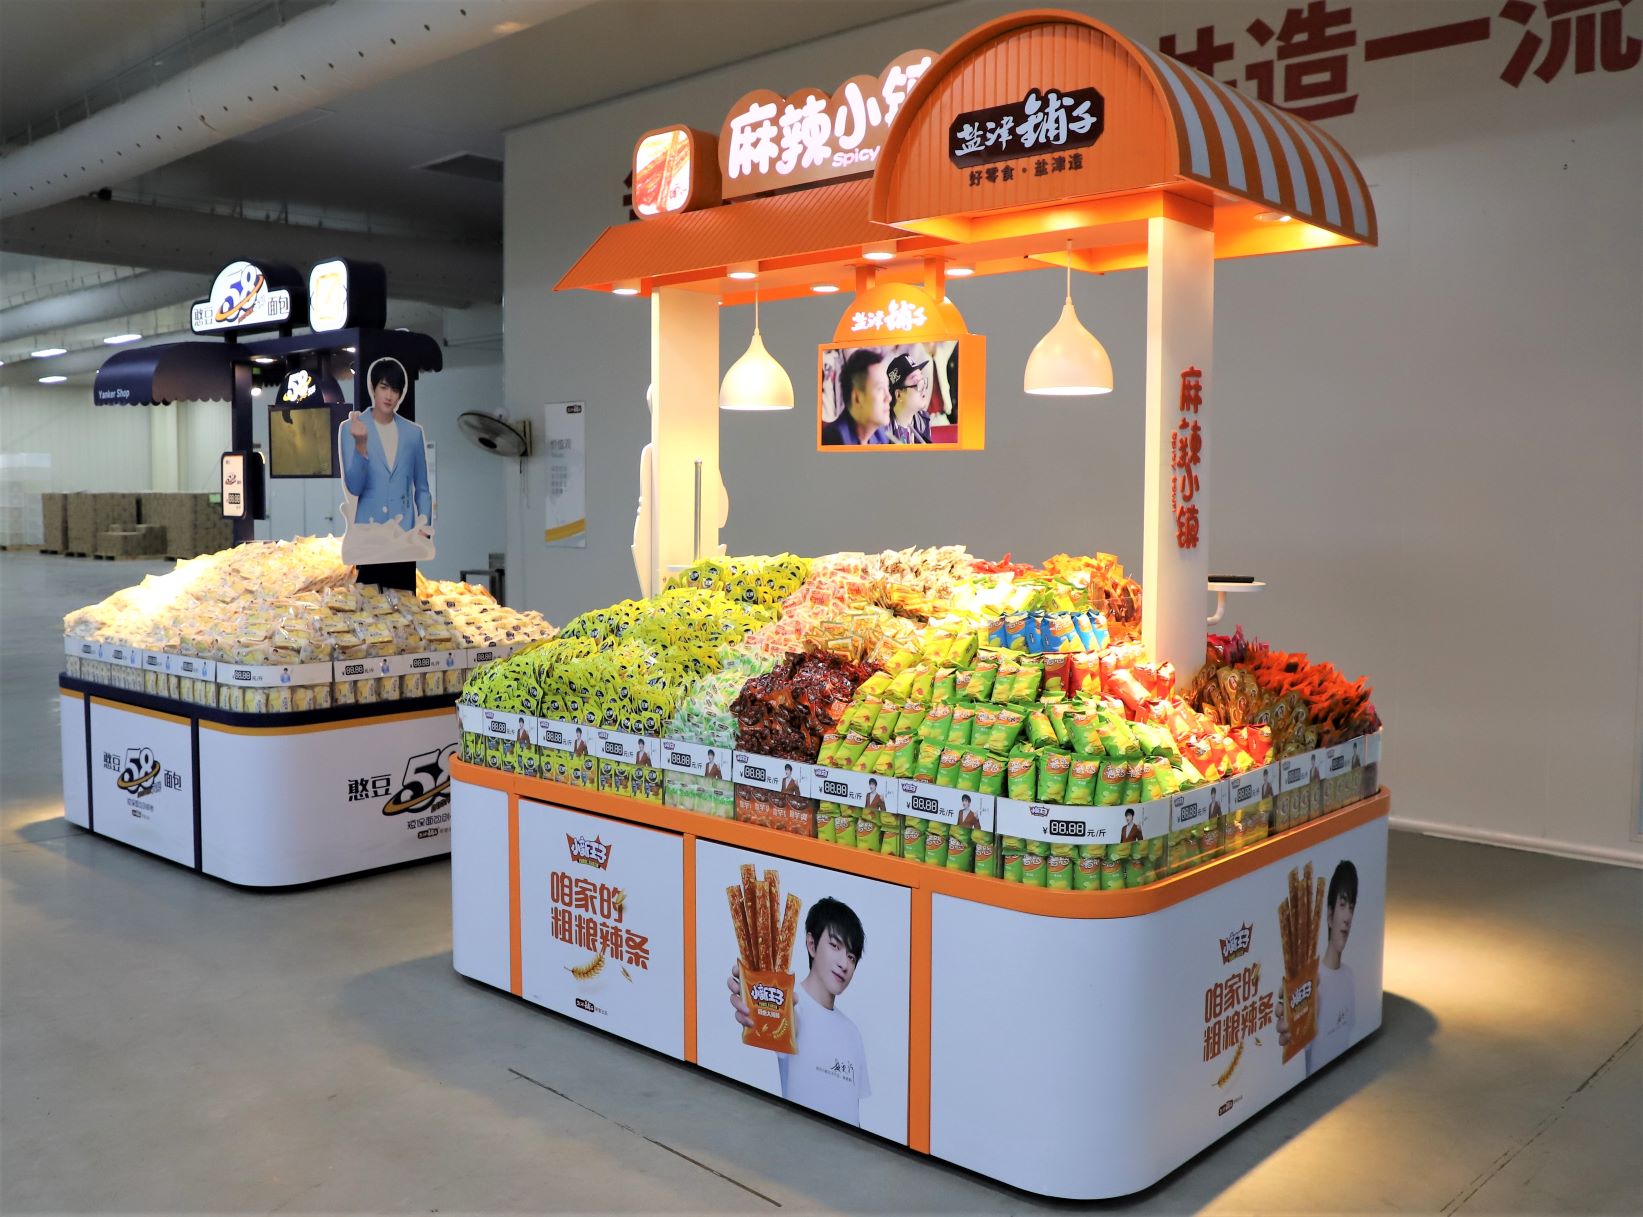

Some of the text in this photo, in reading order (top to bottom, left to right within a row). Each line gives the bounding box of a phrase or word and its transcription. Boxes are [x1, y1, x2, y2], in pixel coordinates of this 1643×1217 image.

[955, 93, 1097, 157] 盐津铺子
[851, 300, 927, 331] 盐津铺子
[117, 388, 130, 399] Shop
[103, 752, 121, 773] 憨豆
[744, 766, 766, 781] 88.88
[164, 769, 182, 792] 面包
[347, 774, 392, 802] 憨豆
[824, 781, 847, 796] 88.88
[912, 797, 938, 812] 88.88
[938, 807, 954, 817] 元/斤
[1051, 821, 1084, 835] 88.88
[1087, 829, 1106, 838] 元/斤
[550, 871, 624, 924] 咱家的
[551, 907, 650, 971] 粗粮辣条
[1204, 963, 1260, 1024] 咱家的
[1203, 992, 1273, 1063] 粗粮辣条
